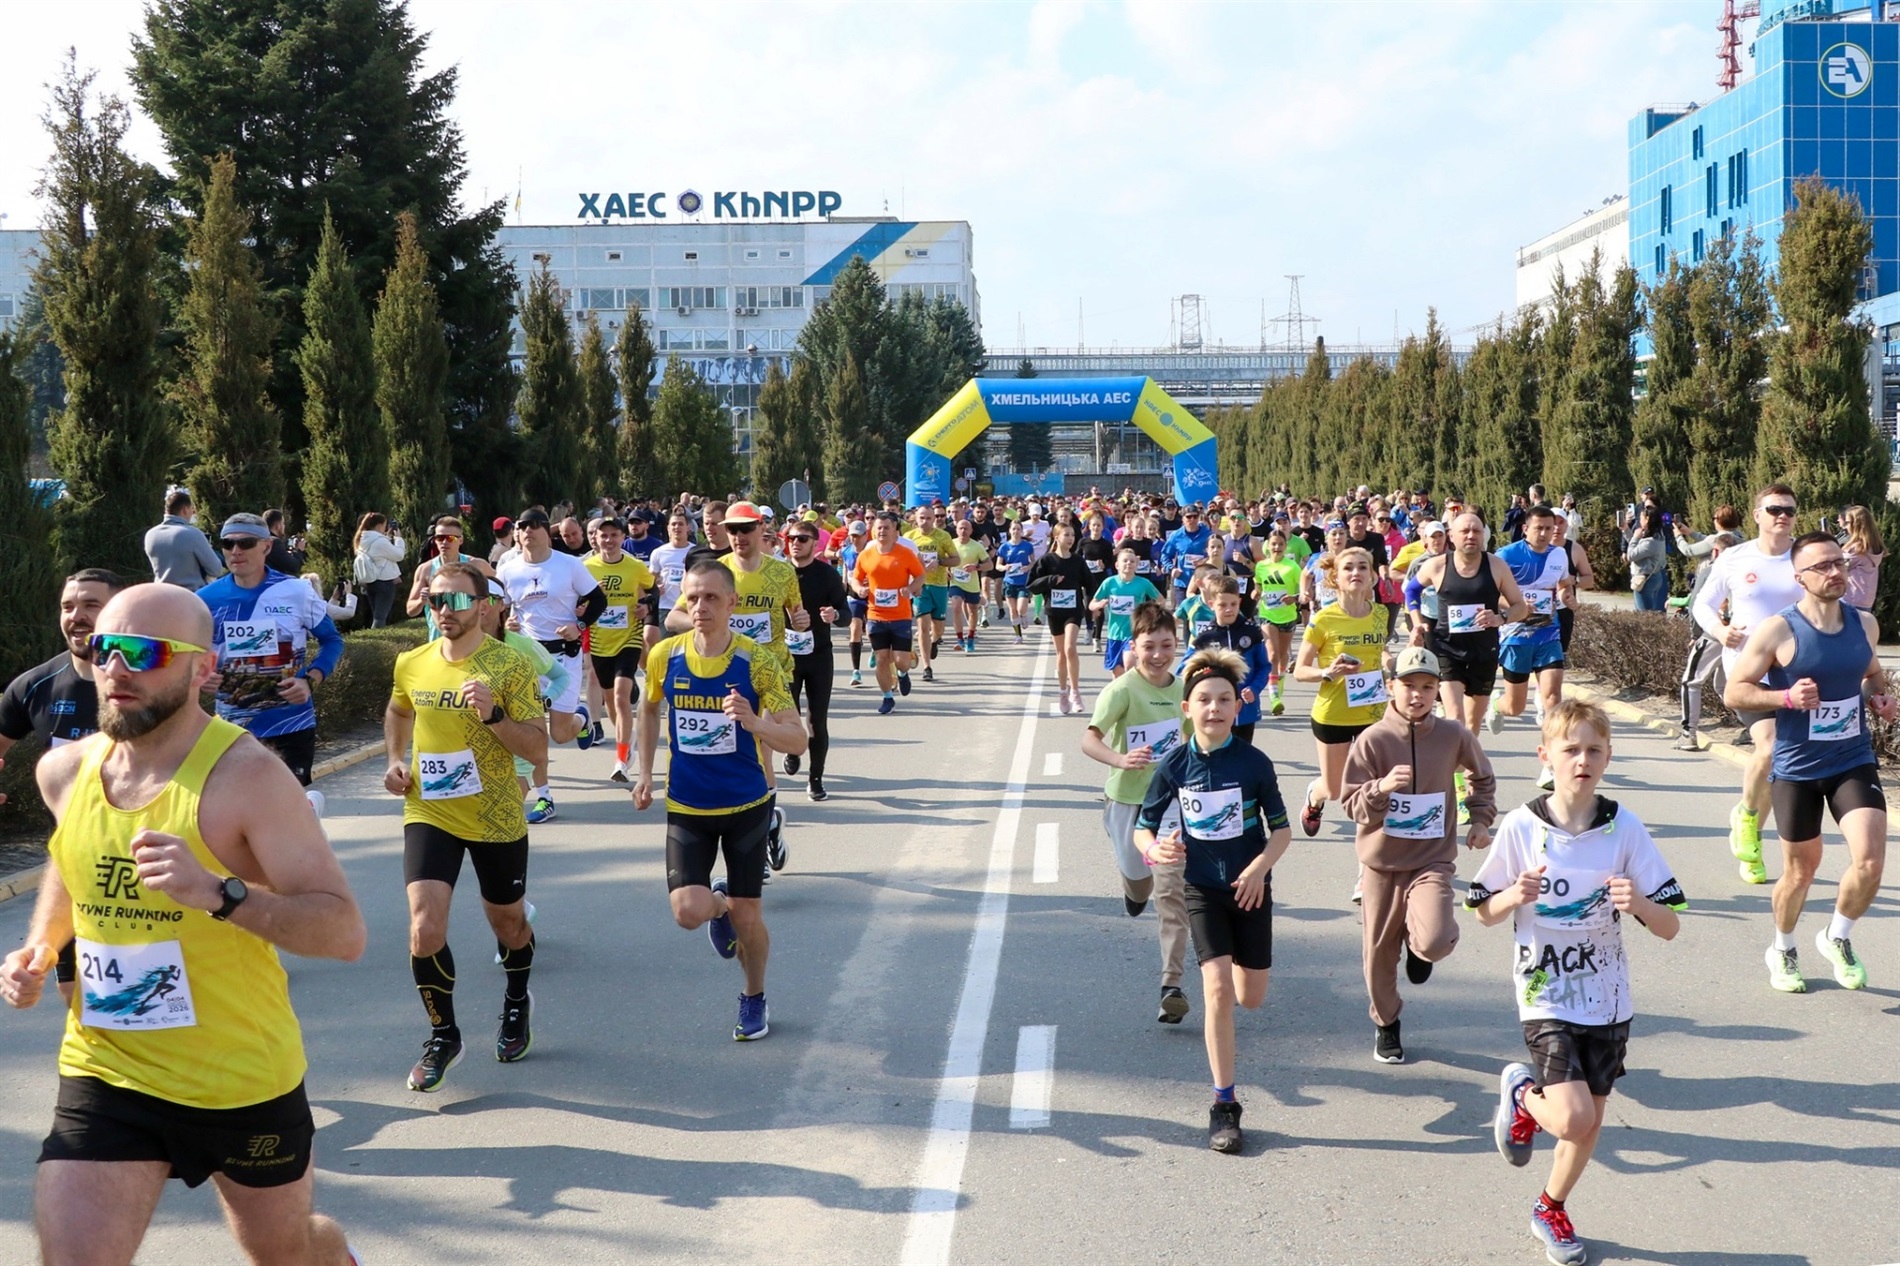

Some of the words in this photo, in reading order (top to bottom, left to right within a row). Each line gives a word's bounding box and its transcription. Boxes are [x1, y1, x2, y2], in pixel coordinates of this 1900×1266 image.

[578, 192, 666, 218] ХАЕС
[714, 191, 842, 218] KhNPP
[991, 393, 1099, 406] ХМЕЛЬНИЦЬКА
[1103, 392, 1131, 404] АЕС
[746, 595, 774, 608] RUN
[1450, 609, 1462, 618] 58
[729, 618, 754, 628] 200
[227, 626, 255, 638] 202
[1348, 678, 1365, 689] 30
[411, 689, 437, 699] Energo
[674, 695, 723, 710] UKRAI
[1815, 707, 1840, 719] 173
[678, 717, 709, 731] 292
[1130, 731, 1146, 743] 71
[421, 760, 447, 774] 283
[1182, 796, 1203, 813] 80
[1389, 799, 1411, 814] 95
[1540, 876, 1570, 897] 90
[115, 906, 184, 922] RUNNING
[82, 952, 124, 984] 214
